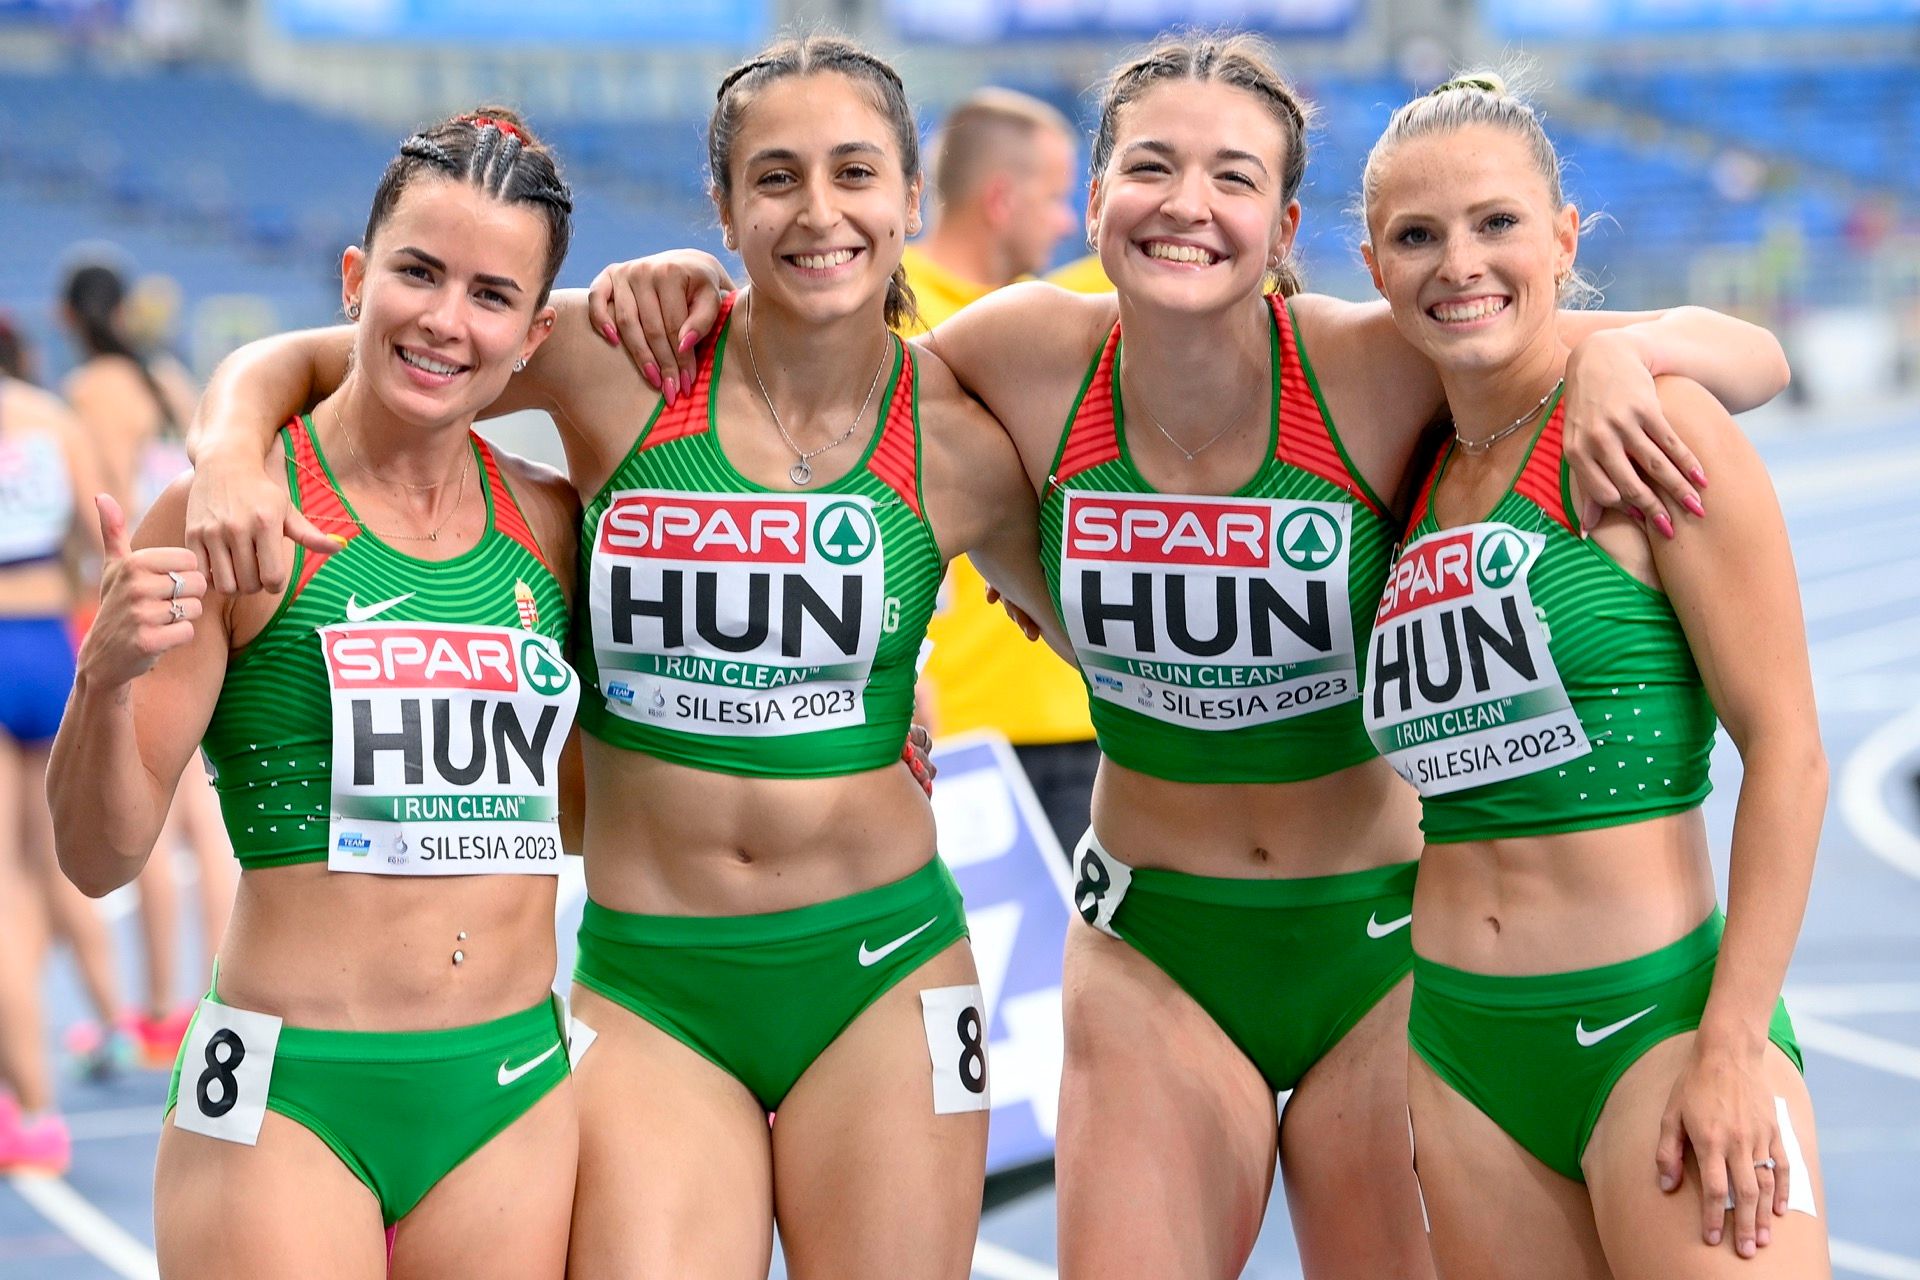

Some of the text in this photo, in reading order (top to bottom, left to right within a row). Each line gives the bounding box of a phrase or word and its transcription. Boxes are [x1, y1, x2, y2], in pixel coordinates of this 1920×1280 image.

[607, 504, 800, 555] SPAR
[1073, 506, 1264, 559] SPAR
[1380, 542, 1469, 617] SPAR
[610, 565, 863, 658] HUN
[883, 597, 901, 633] G
[1081, 570, 1332, 657] HUN
[332, 637, 513, 683] SPAR
[653, 656, 660, 672] I
[666, 657, 716, 681] RUN
[1127, 661, 1135, 674] I
[1139, 662, 1192, 685] RUN
[1373, 595, 1538, 719] HUN
[676, 689, 856, 724] SILESIA 2023
[1162, 678, 1348, 720] SILESIA 2023
[351, 698, 559, 787] HUN
[1396, 724, 1402, 747] I
[1403, 716, 1439, 745] RUN
[1417, 724, 1577, 784] SILESIA 2023
[393, 798, 399, 819] I
[405, 797, 453, 819] RUN
[343, 837, 365, 848] TEAM
[420, 835, 557, 861] SILESIA 2023
[1074, 848, 1111, 925] 8
[196, 1027, 246, 1118] 8
[957, 1006, 987, 1094] 8
